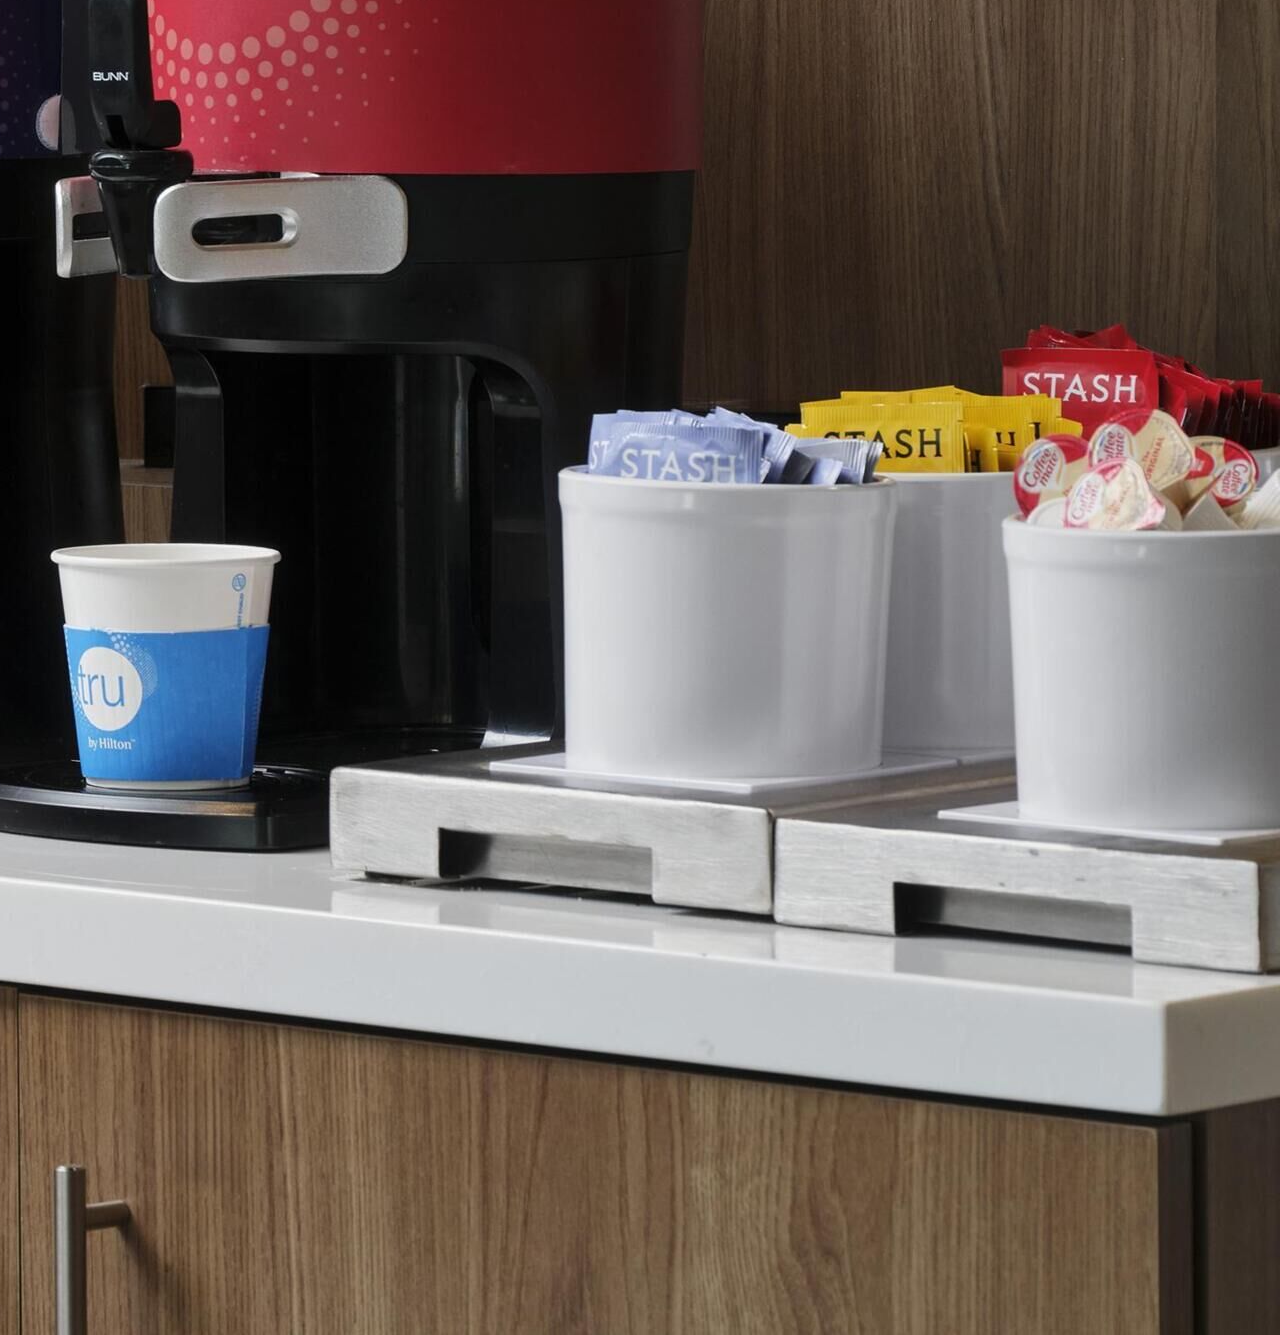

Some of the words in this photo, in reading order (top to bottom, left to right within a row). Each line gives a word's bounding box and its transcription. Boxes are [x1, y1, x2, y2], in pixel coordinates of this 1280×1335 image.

[92, 71, 129, 82] BUNN
[1023, 371, 1139, 404] STASH
[620, 448, 737, 484] STASH
[1023, 448, 1052, 488] Coffee
[1039, 451, 1058, 488] mate
[77, 664, 125, 707] tru
[87, 736, 98, 751] by
